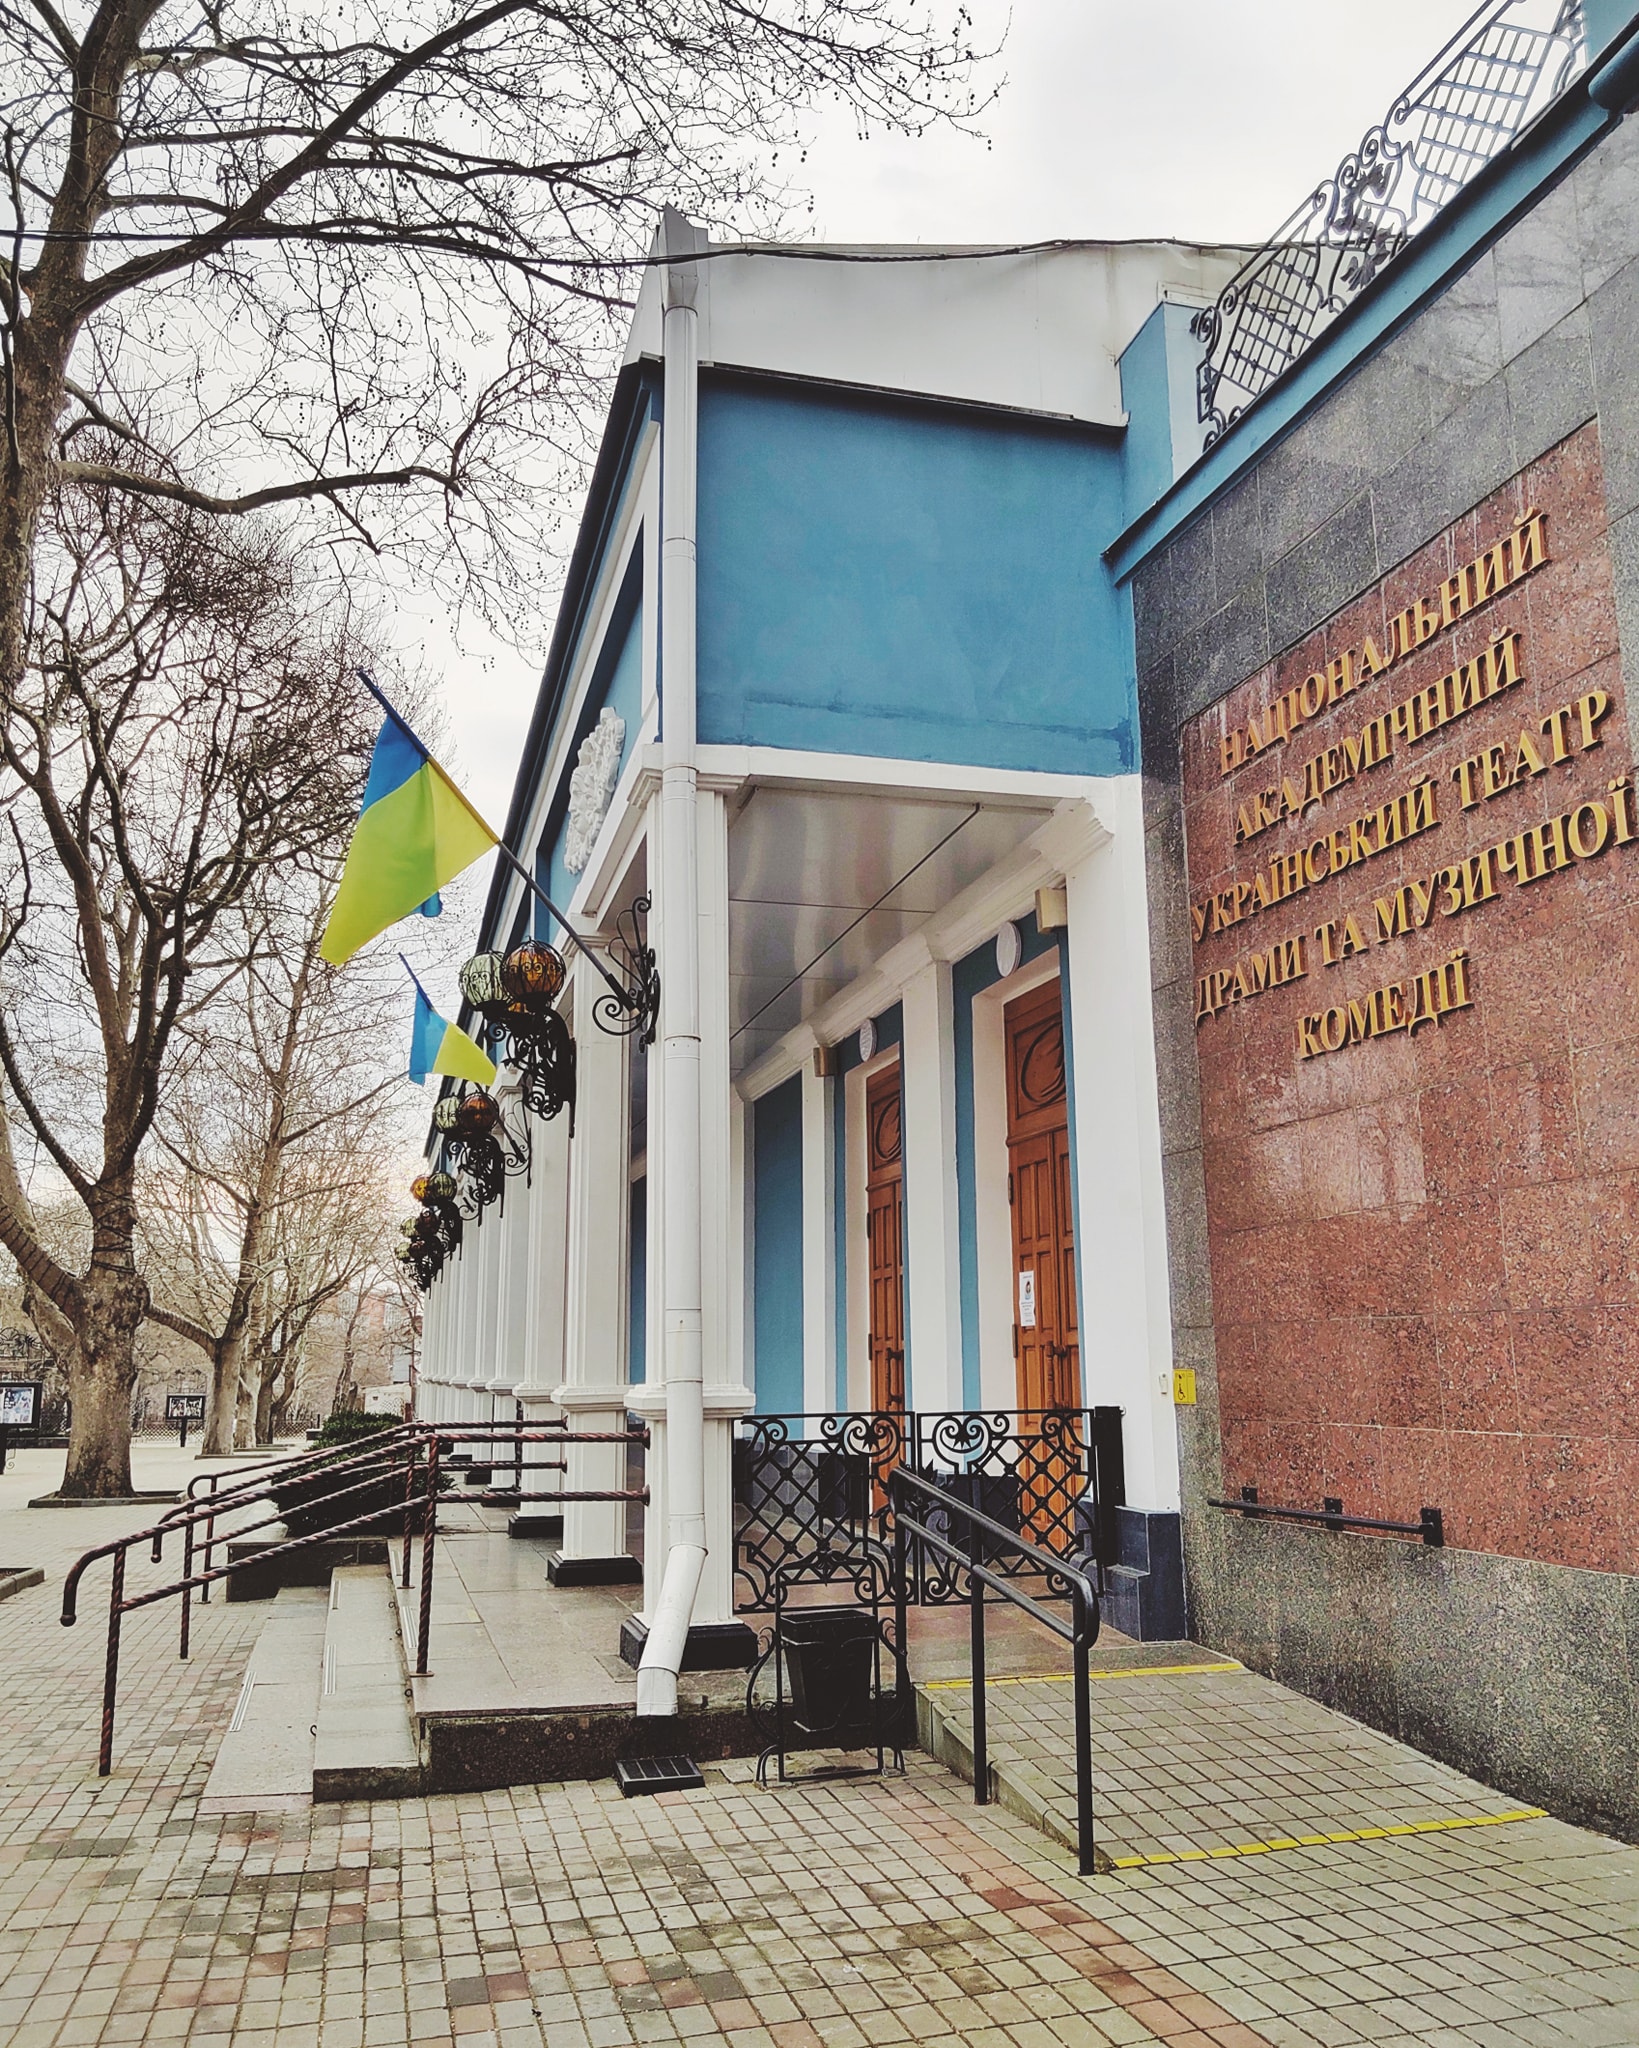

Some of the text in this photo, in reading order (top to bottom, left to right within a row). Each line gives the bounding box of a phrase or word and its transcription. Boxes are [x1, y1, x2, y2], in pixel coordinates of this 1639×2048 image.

[1219, 508, 1549, 776] НАЦІОНАЛЬНИЙ
[1233, 626, 1525, 844] АКАДЕМІЧНИЙ
[1192, 690, 1611, 937] УКРАЇНСЬКИЙ ТЕАТР
[1196, 777, 1638, 1022] ДРАМИ ТА МУЗИЧНОЇ
[1296, 949, 1473, 1059] КОМЕДІЇ
